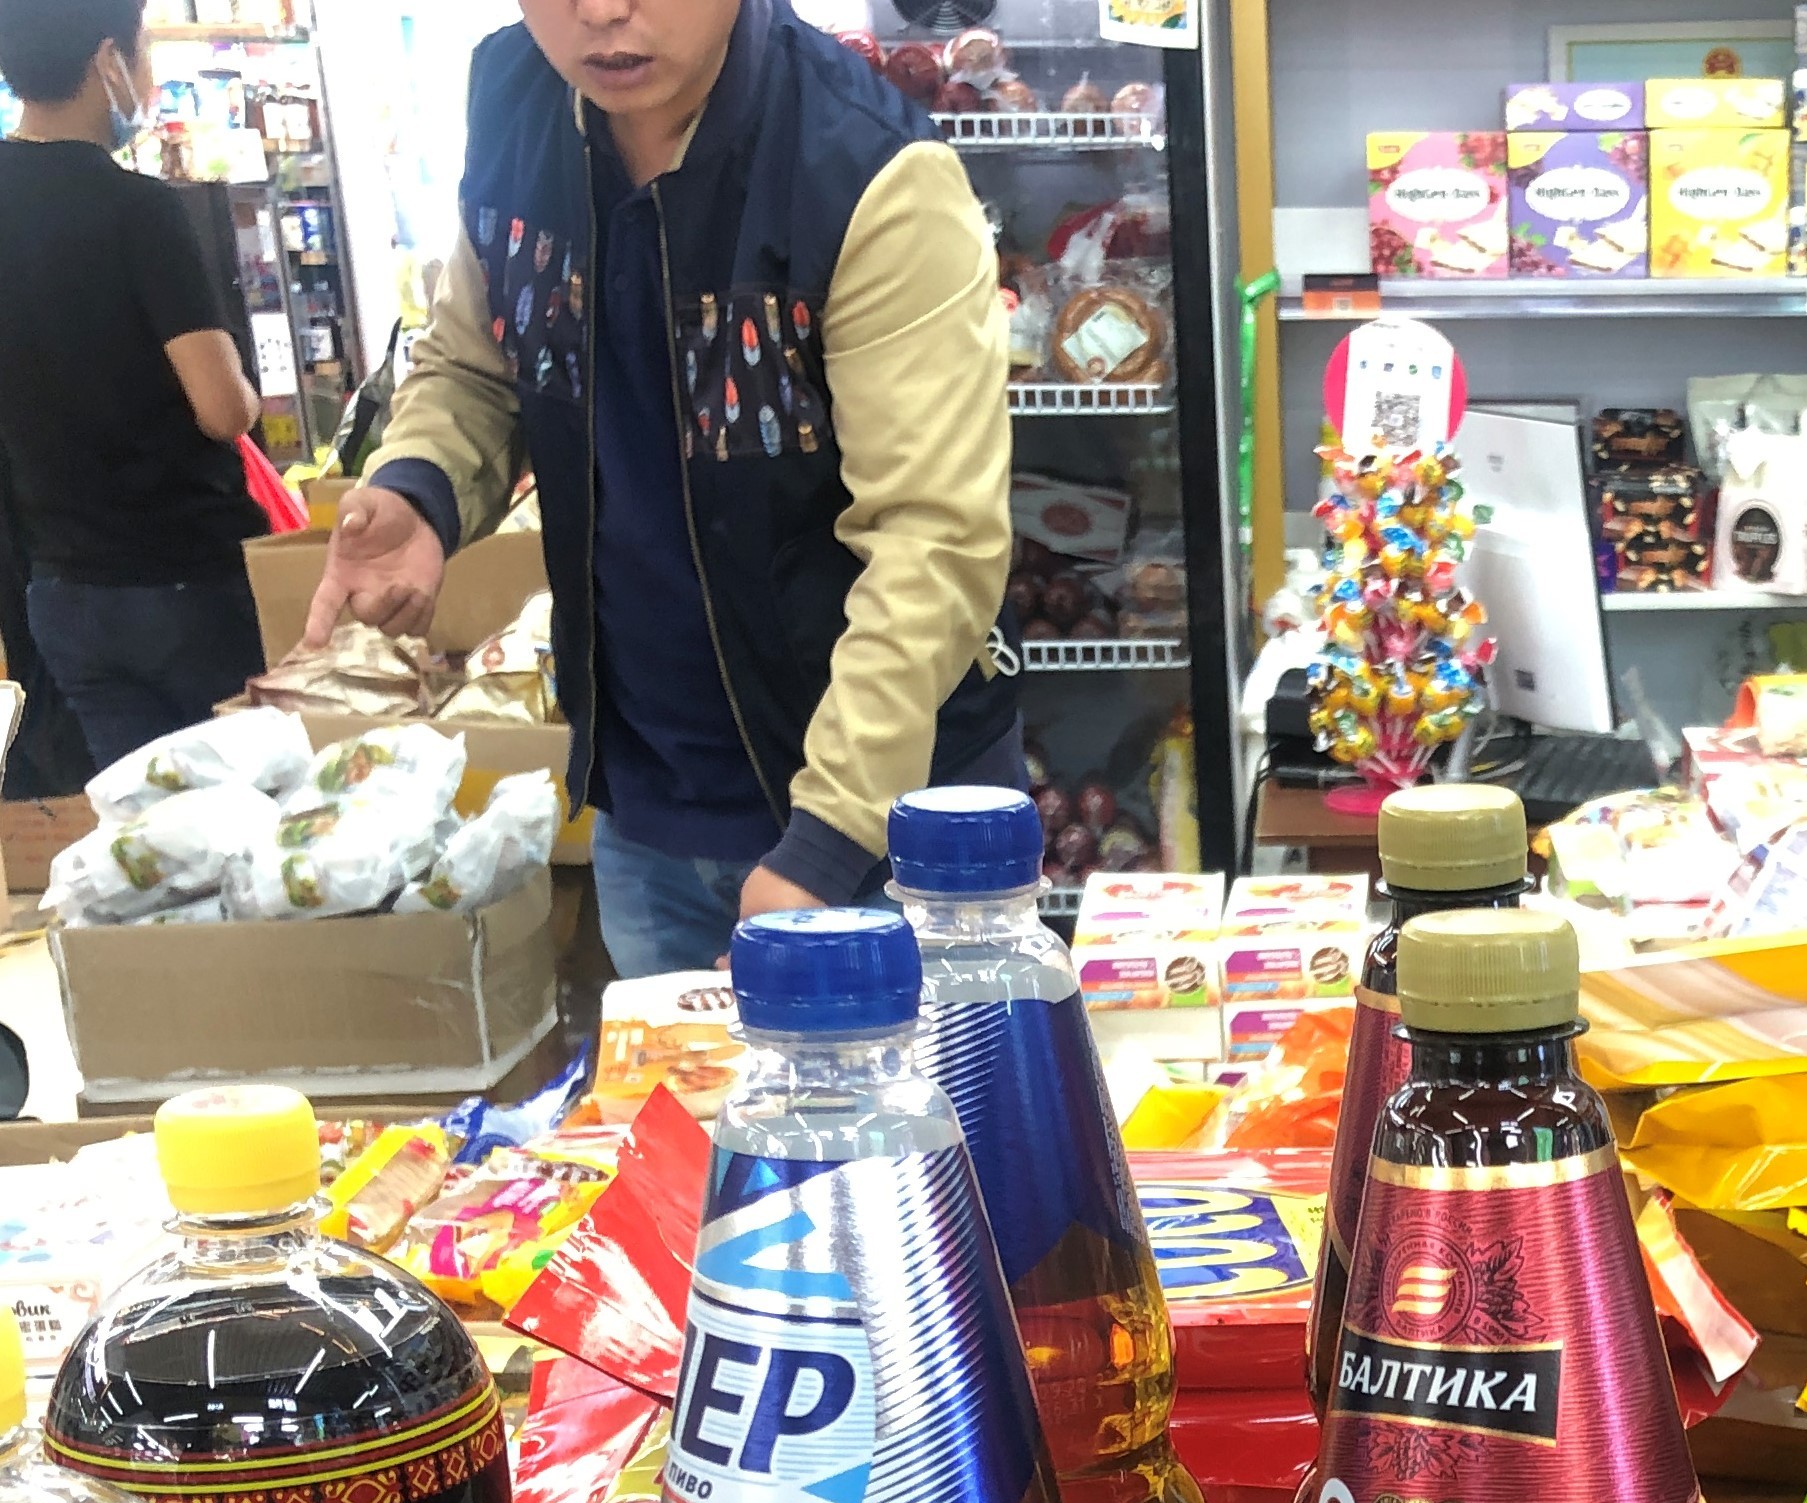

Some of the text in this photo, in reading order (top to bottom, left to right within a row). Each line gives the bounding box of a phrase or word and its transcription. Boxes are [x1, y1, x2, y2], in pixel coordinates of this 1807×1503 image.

[11, 1299, 52, 1317] вик
[672, 1318, 857, 1477] ЕР
[1339, 1350, 1539, 1413] БАЛТИКА
[667, 1462, 713, 1500] ПИВО
